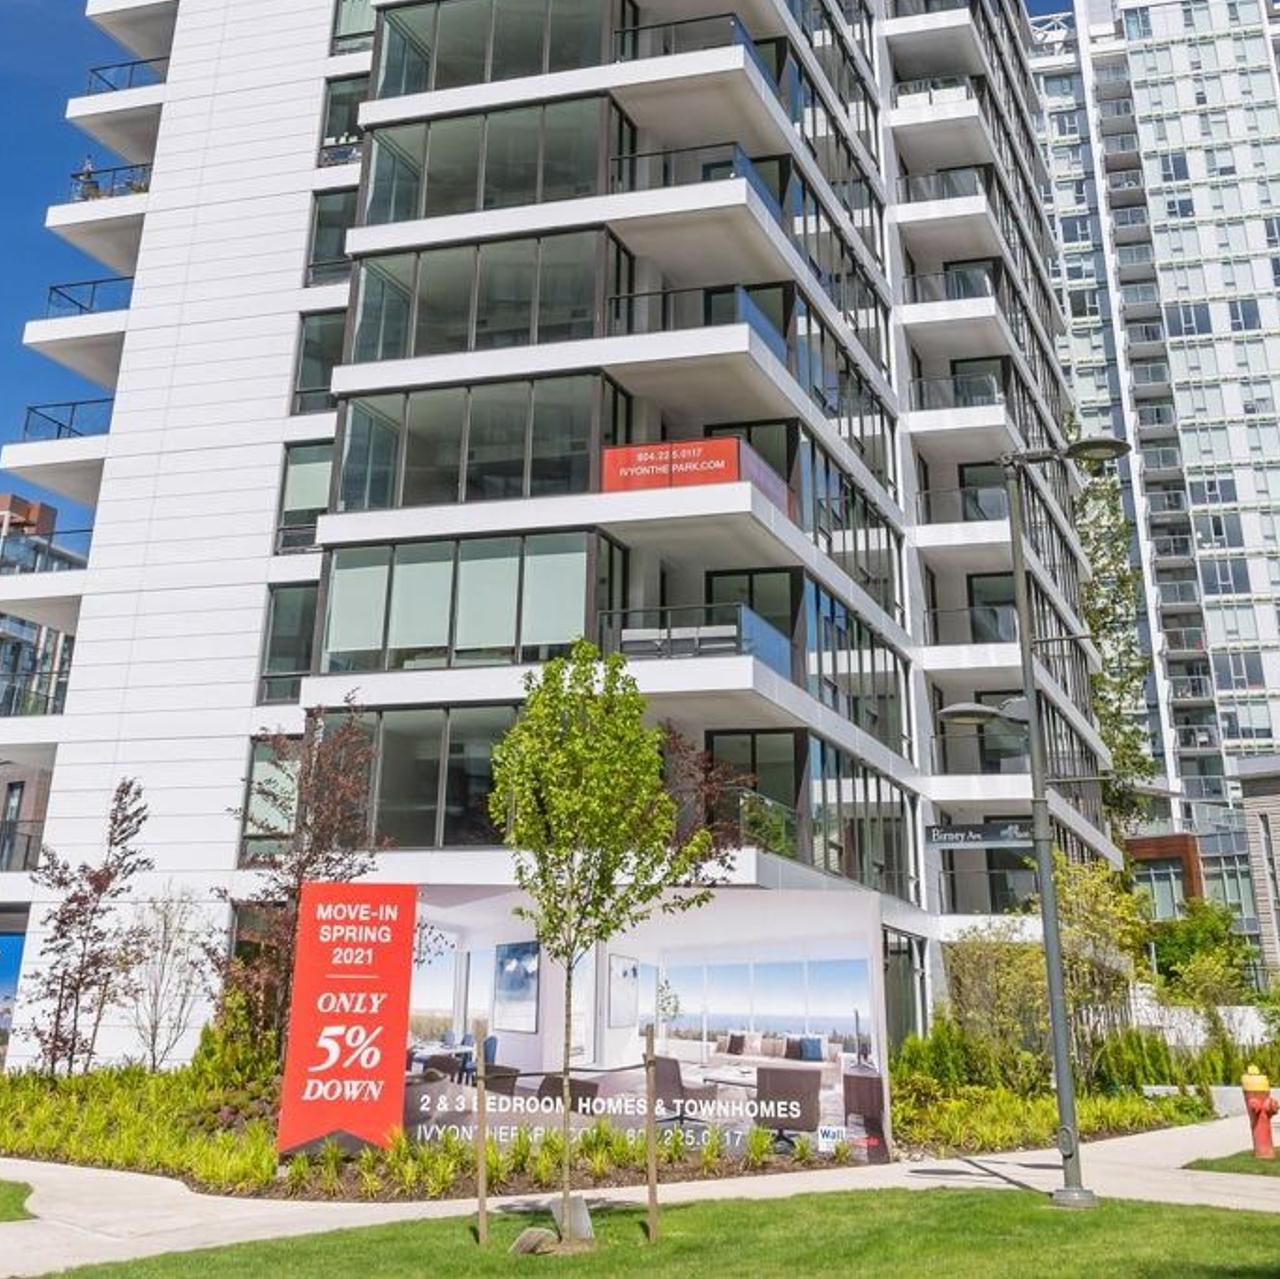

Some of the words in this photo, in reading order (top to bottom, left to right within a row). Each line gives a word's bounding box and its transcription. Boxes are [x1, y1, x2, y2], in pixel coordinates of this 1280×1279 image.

[316, 903, 397, 921] MOVE-IN
[320, 925, 391, 942] SPRING
[331, 947, 373, 964] 2021
[317, 992, 388, 1013] ONLY
[308, 1025, 383, 1072] 5%
[301, 1079, 384, 1101] DOWN
[420, 1095, 431, 1111] 2
[437, 1096, 448, 1112] &
[456, 1096, 466, 1112] 3
[578, 1097, 647, 1115] HOMES
[655, 1099, 667, 1116] &
[672, 1099, 801, 1118] TOWNHOMES
